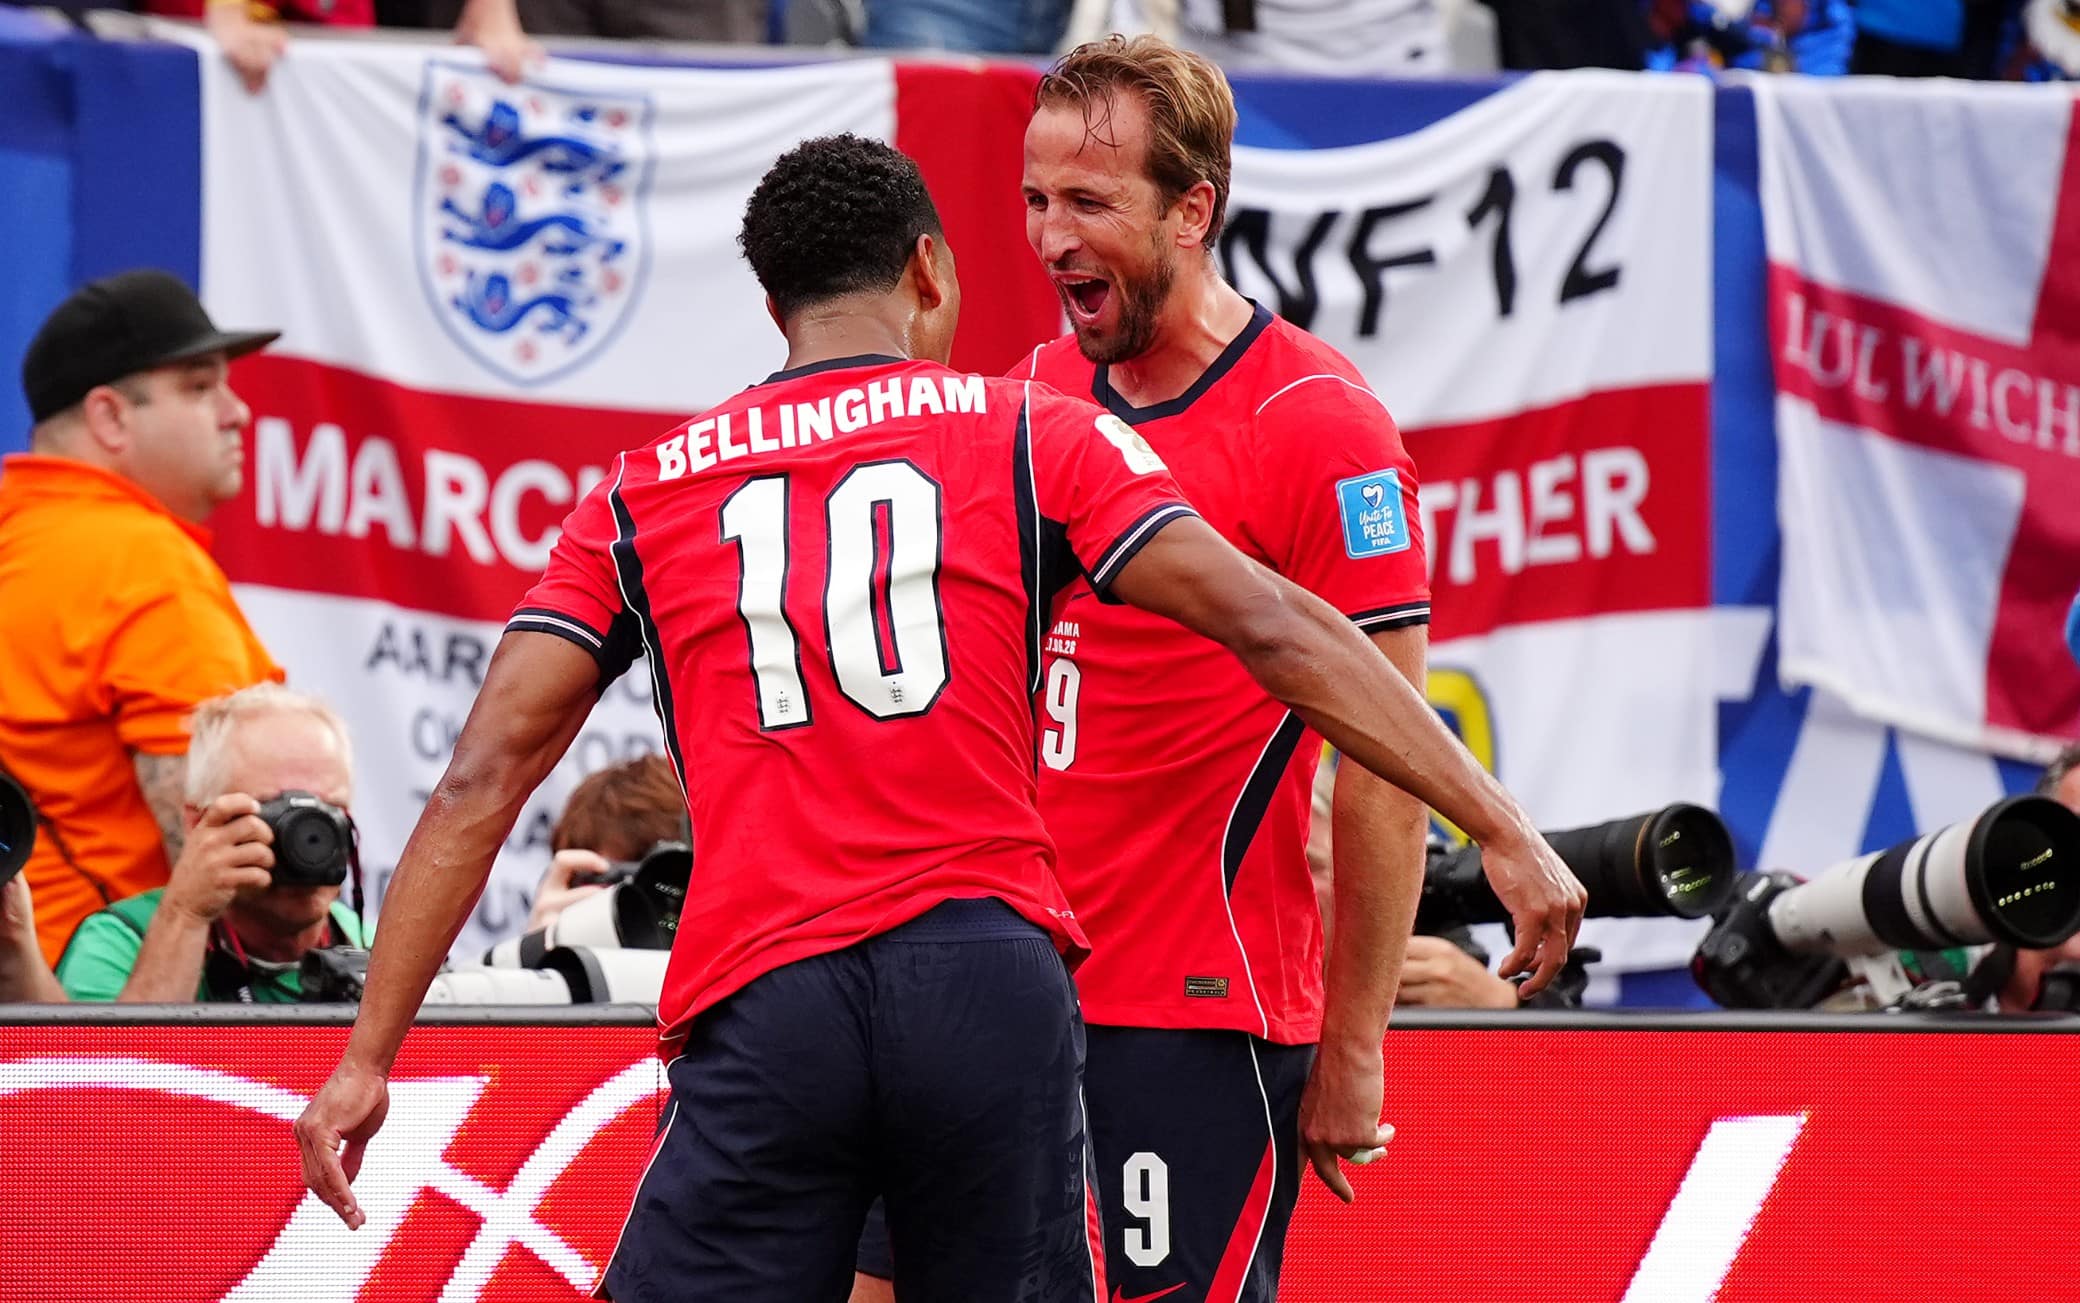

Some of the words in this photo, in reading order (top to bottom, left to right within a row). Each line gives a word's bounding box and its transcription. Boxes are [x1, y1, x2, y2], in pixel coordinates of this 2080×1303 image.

[656, 375, 987, 482] BELLINGHAM
[1363, 520, 1396, 539] PEACE
[1371, 537, 1391, 547] FIFA
[718, 457, 951, 732] 10
[1042, 656, 1082, 772] 9
[1123, 1151, 1170, 1267] 9
